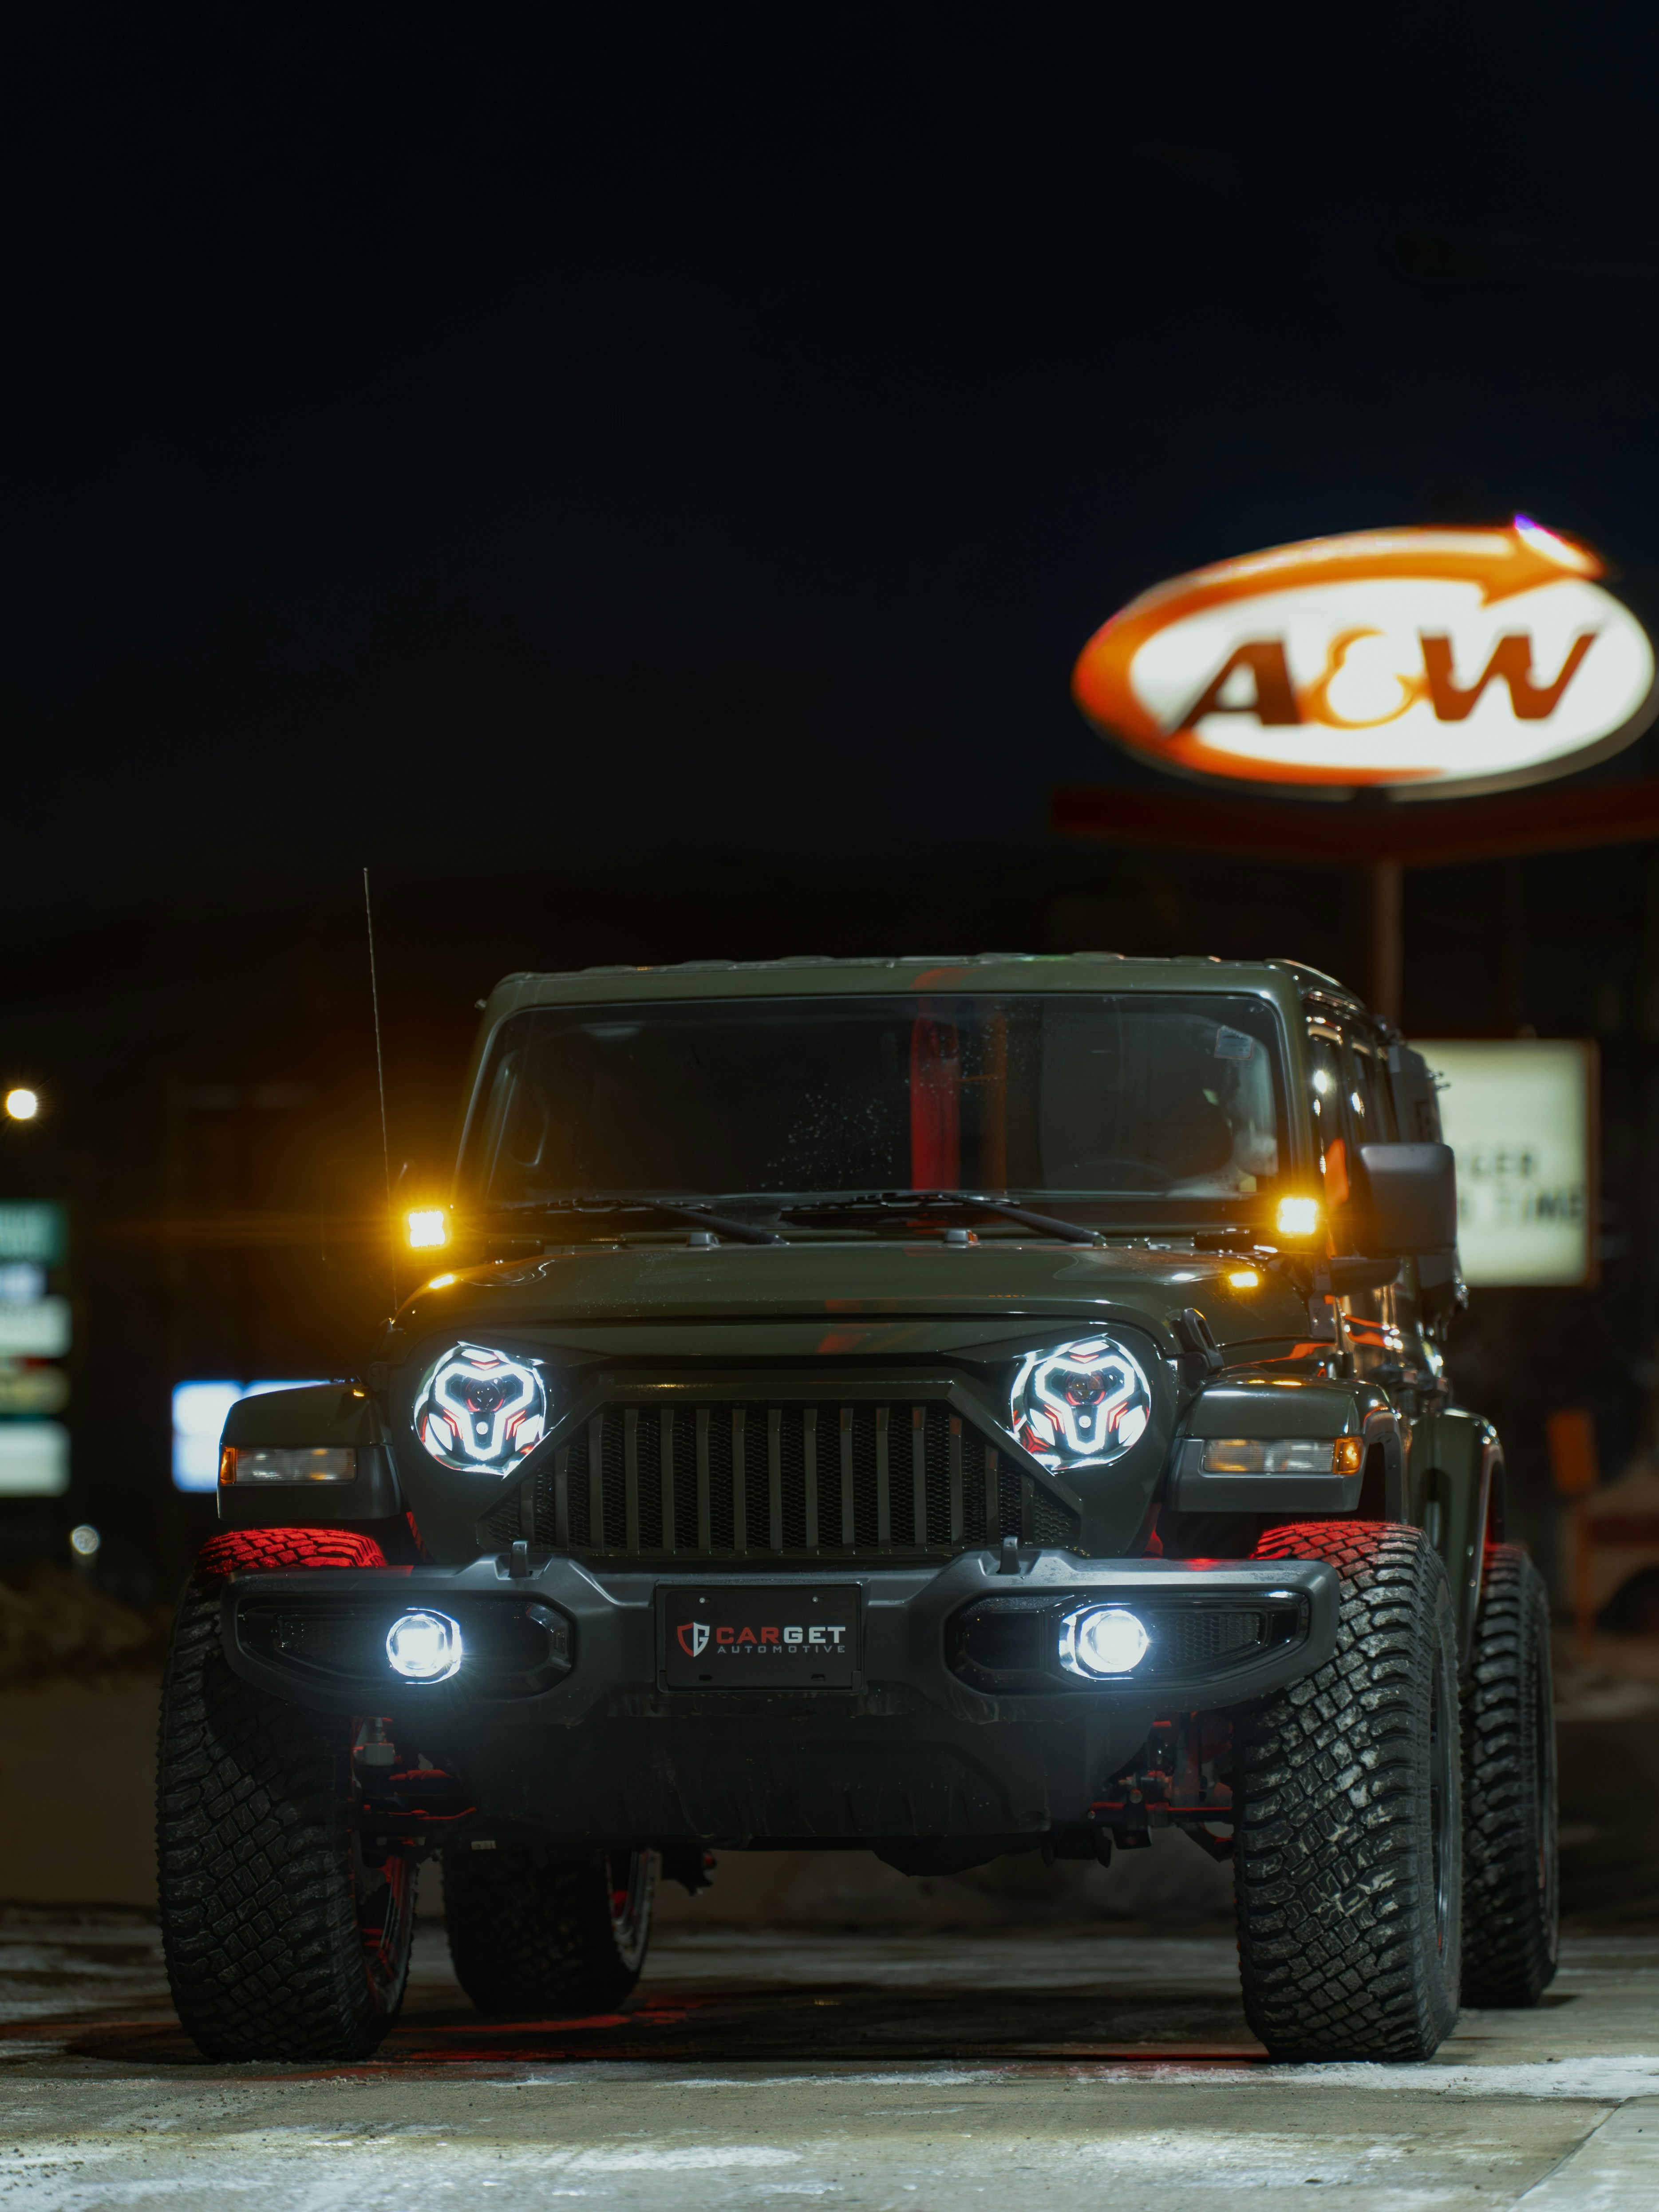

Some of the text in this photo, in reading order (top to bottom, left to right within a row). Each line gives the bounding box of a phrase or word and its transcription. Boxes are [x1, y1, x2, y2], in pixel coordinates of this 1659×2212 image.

[1166, 628, 1599, 738] A&W
[716, 1626, 846, 1644] CARGET
[716, 1645, 846, 1654] AUTOMOTIVE
